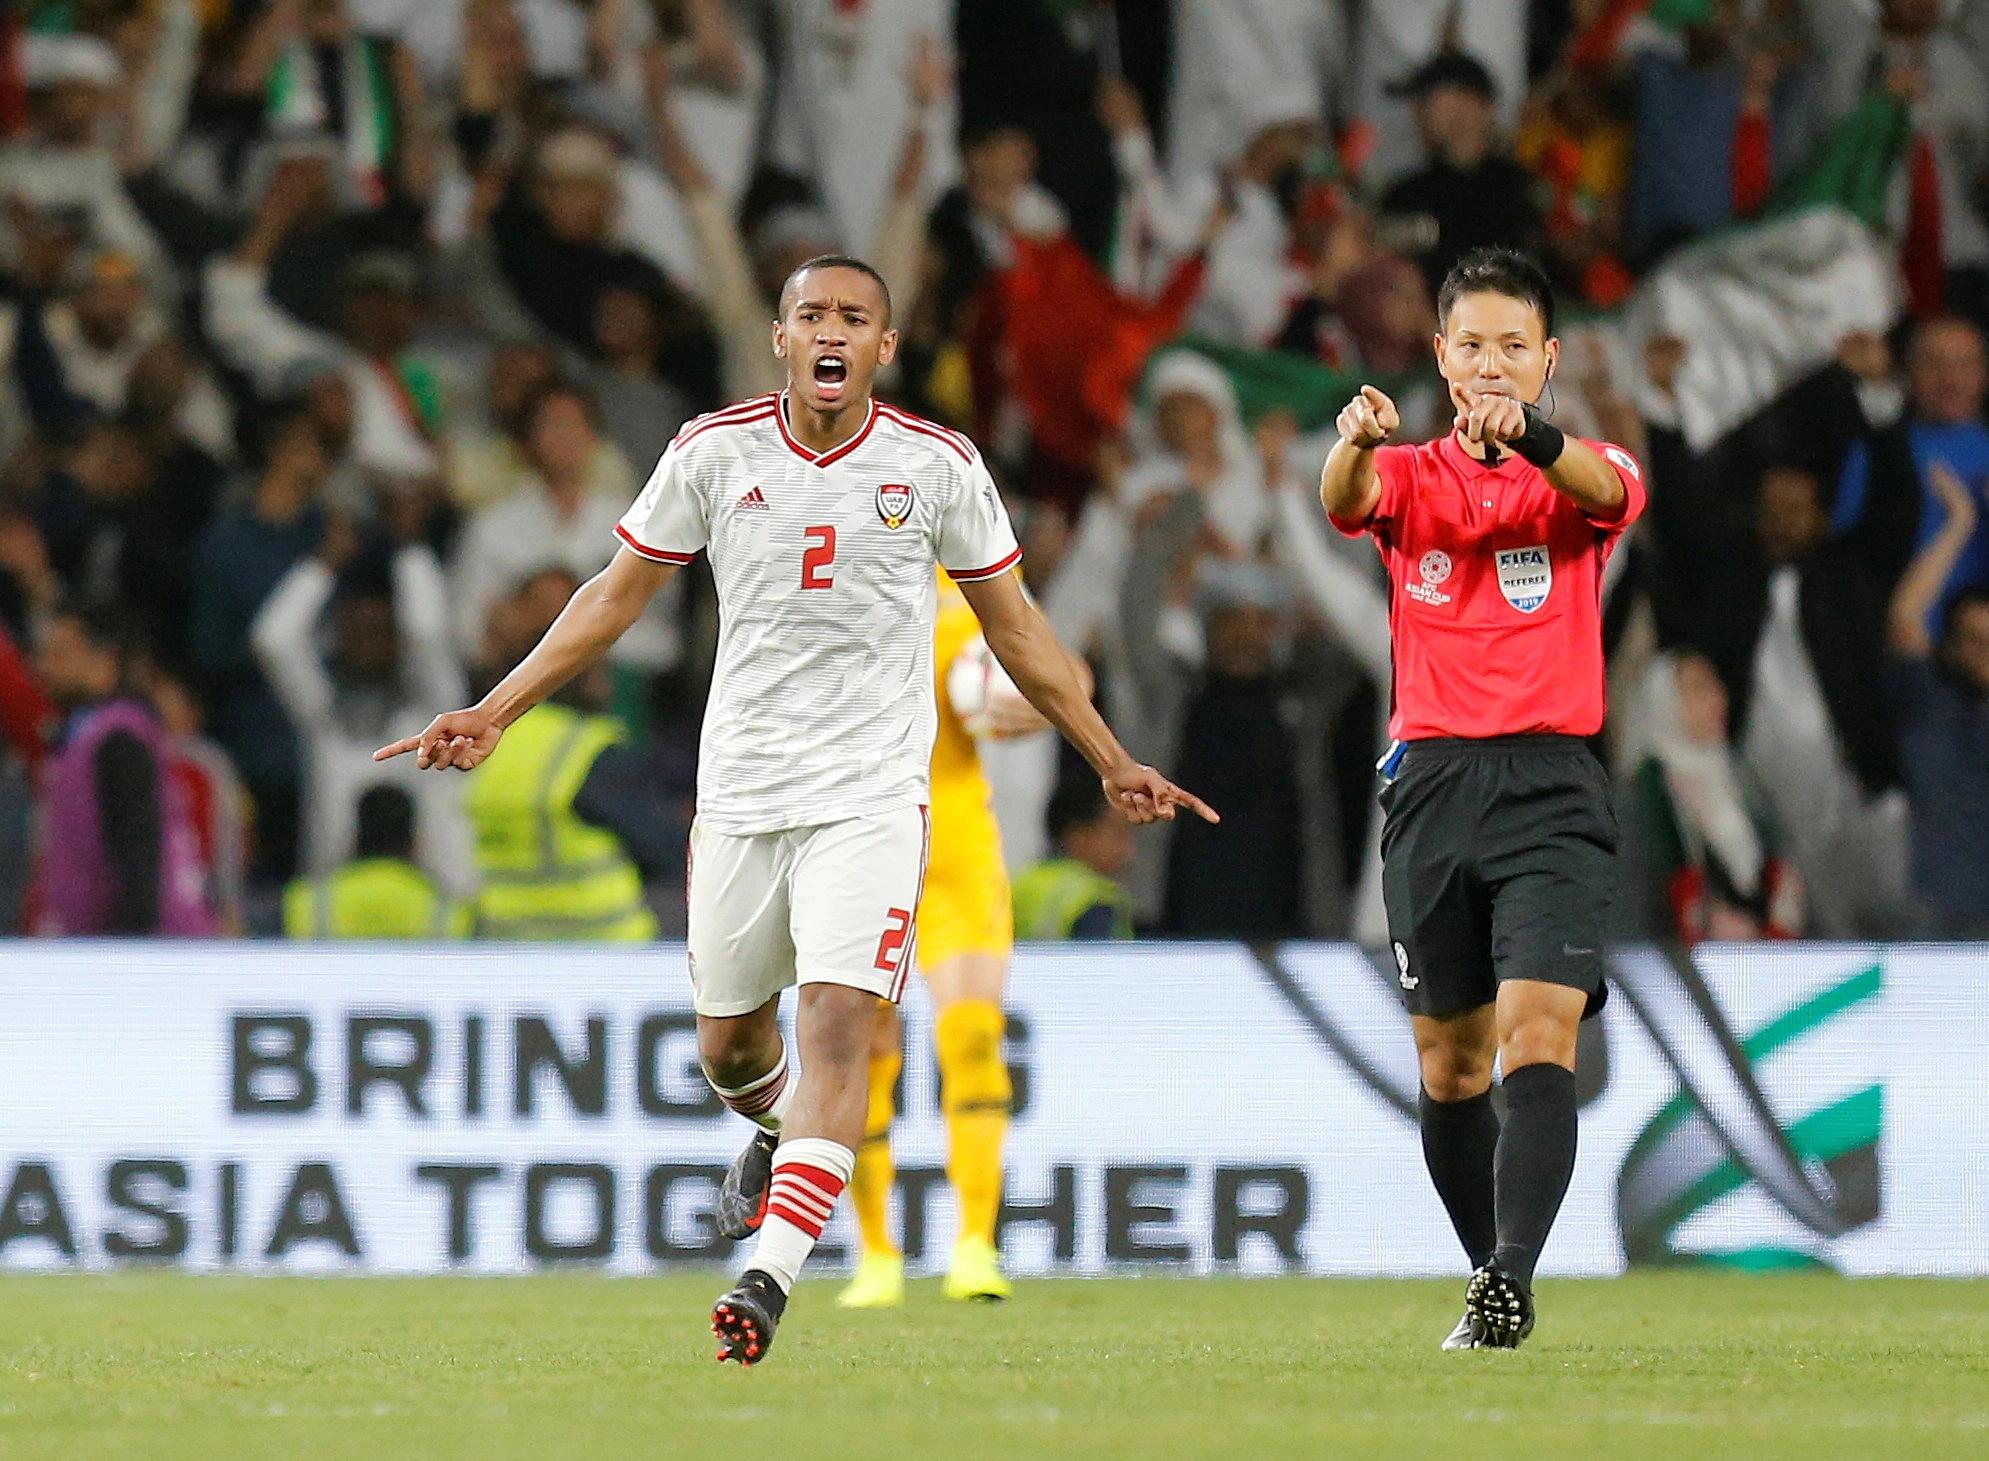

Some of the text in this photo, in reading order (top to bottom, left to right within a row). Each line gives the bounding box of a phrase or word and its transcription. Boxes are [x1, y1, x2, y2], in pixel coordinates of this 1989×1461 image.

[802, 526, 836, 590] 2
[1501, 551, 1544, 567] FIFA
[1503, 576, 1546, 587] REFEREE
[874, 907, 910, 972] 2
[231, 1013, 1028, 1117] BRING
[0, 1160, 1309, 1260] ASIA TOGTHER
